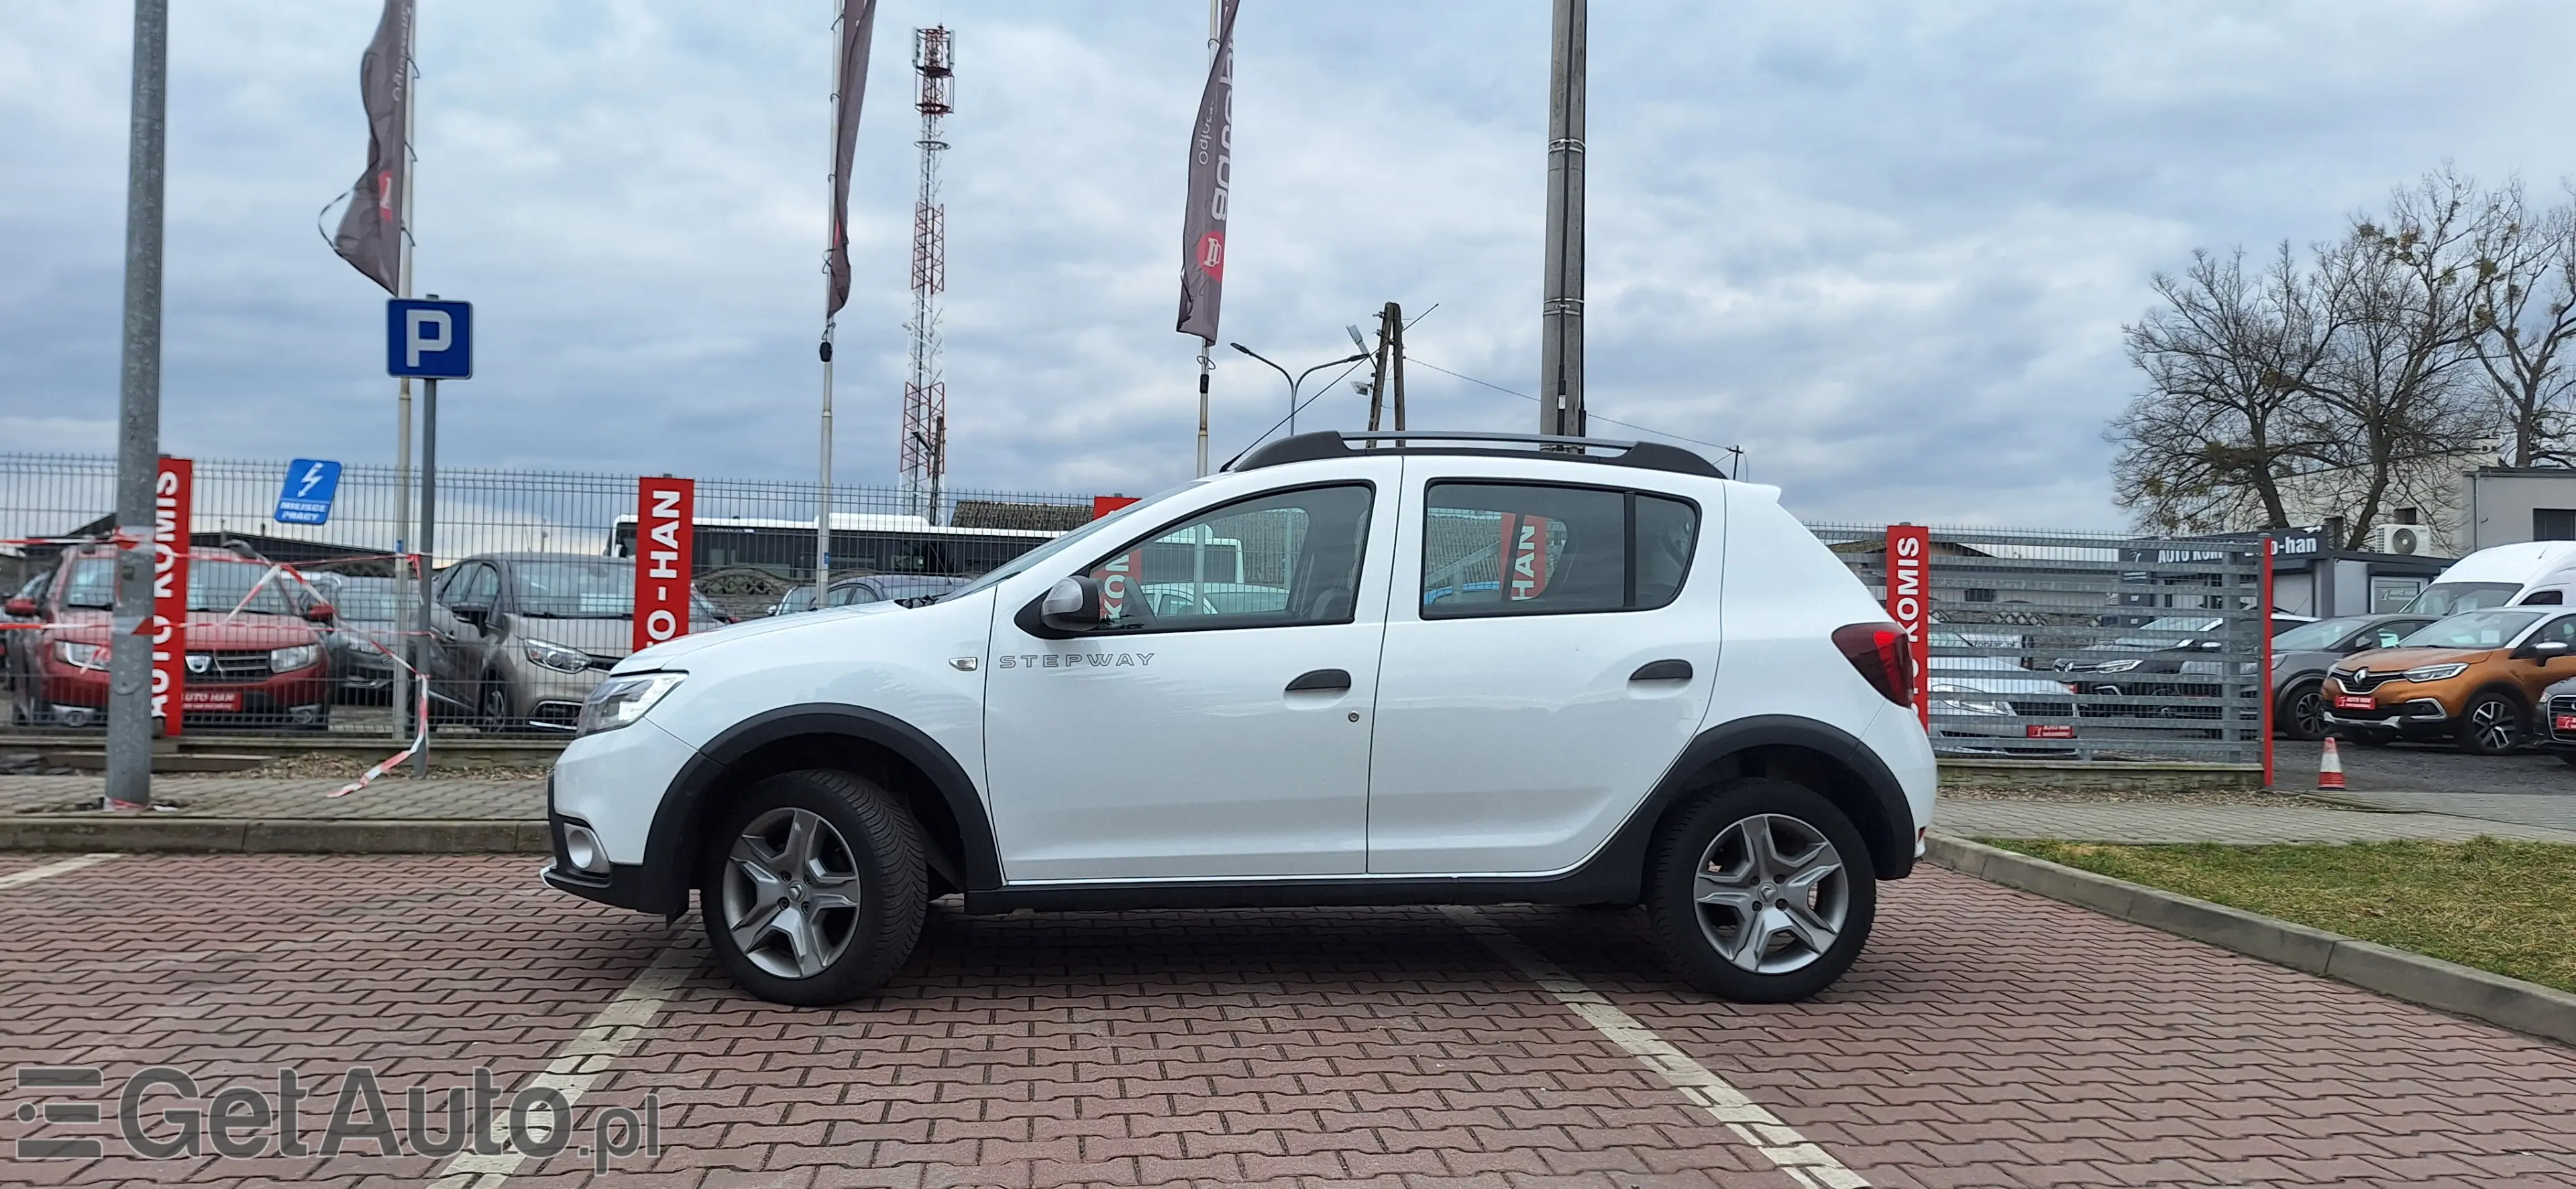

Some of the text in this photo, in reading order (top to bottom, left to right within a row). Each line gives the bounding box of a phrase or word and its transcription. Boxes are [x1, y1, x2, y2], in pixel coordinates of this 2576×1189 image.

[406, 308, 451, 367] P
[1896, 537, 1919, 642] KOMIS
[1000, 653, 1155, 669] STEPWAY
